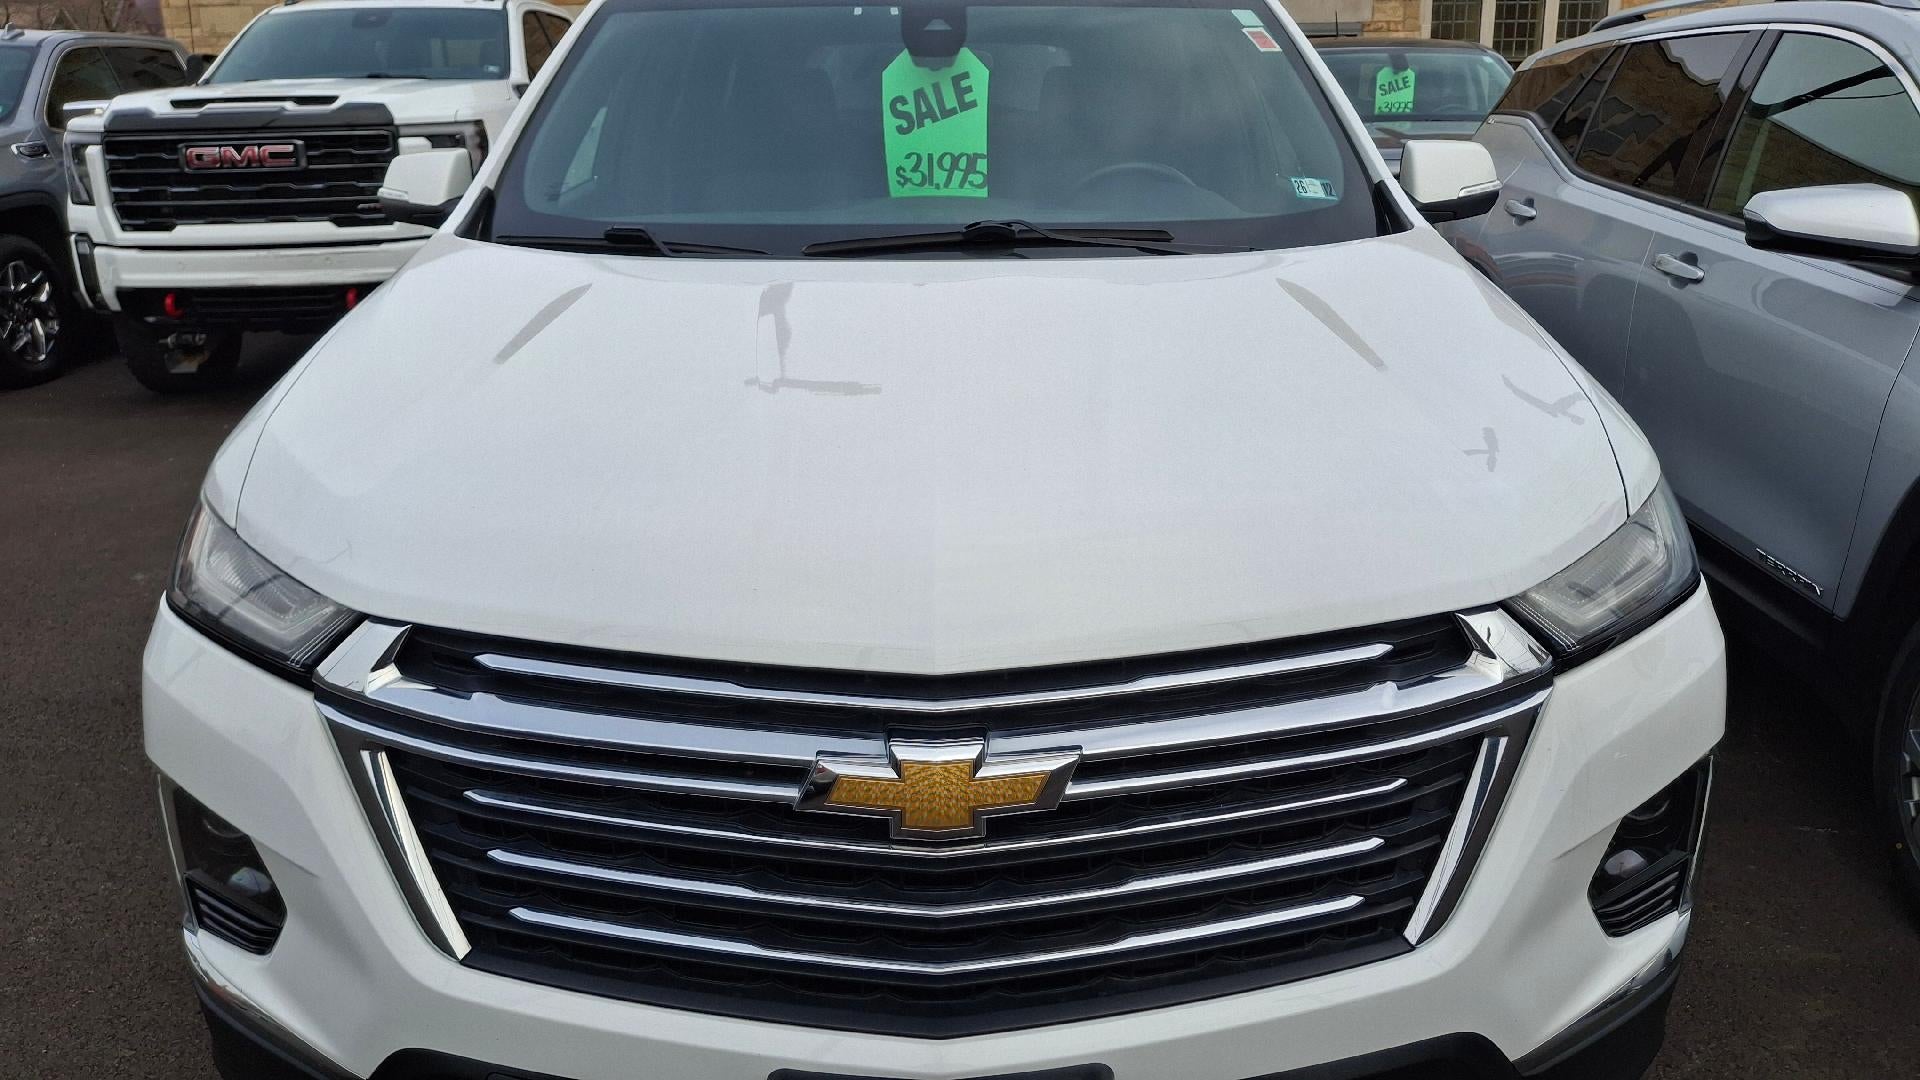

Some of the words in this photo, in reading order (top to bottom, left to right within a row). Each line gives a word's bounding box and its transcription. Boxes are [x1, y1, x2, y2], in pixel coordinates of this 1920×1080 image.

[1379, 76, 1410, 96] SALE
[889, 71, 978, 135] SALE
[186, 144, 297, 168] GMC
[895, 152, 987, 189] $31,995
[1294, 180, 1308, 194] 26
